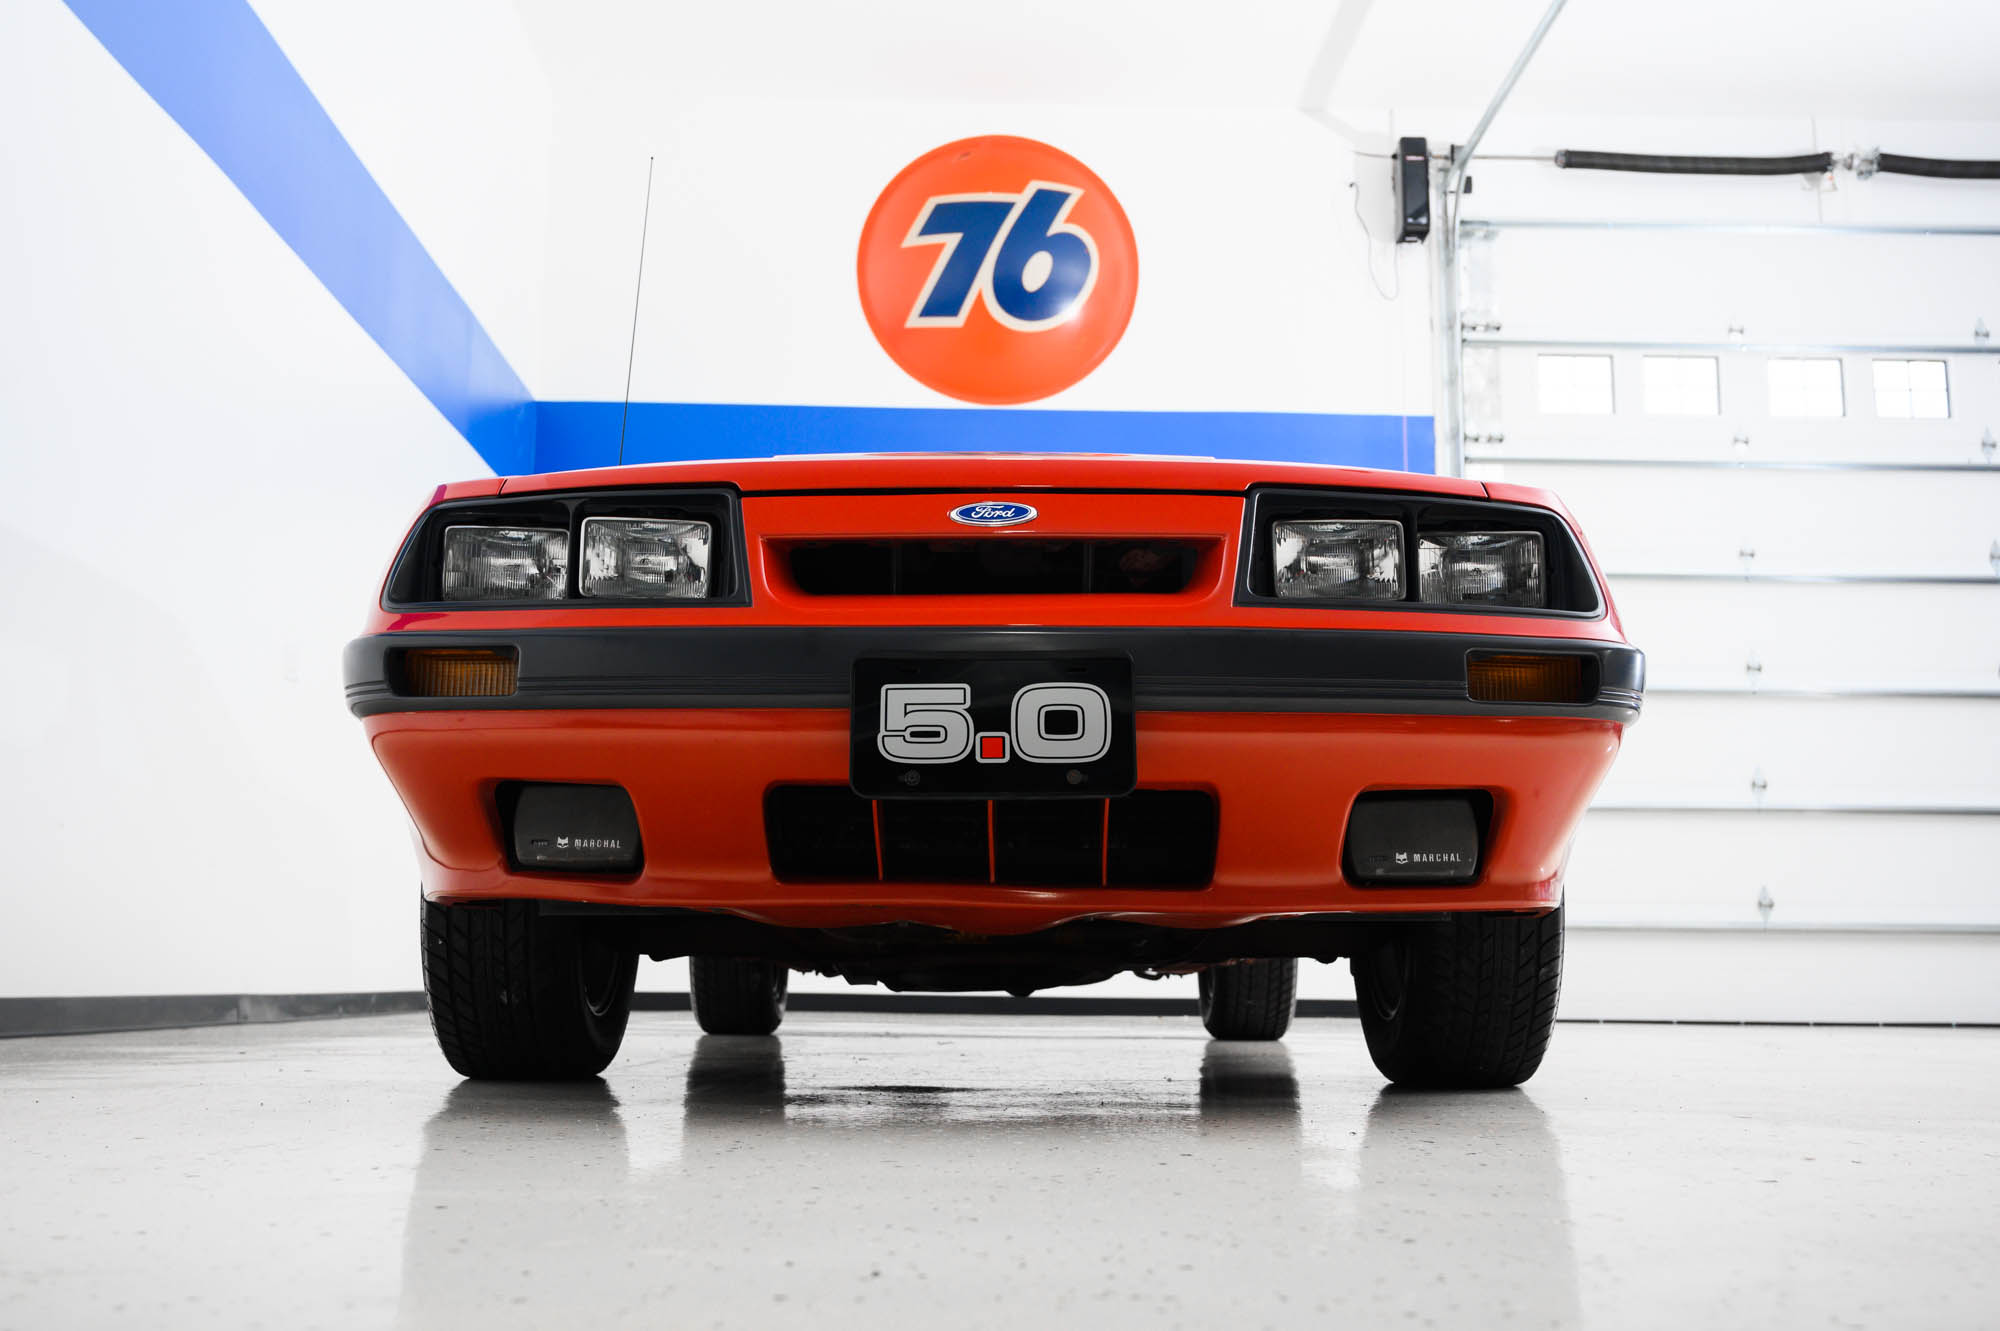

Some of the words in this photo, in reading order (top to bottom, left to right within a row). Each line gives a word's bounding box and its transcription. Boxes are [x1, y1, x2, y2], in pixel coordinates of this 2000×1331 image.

[901, 180, 1100, 333] 76
[971, 505, 1016, 518] Ford
[877, 682, 1112, 764] 5.0
[574, 838, 621, 849] MARCHAL
[1413, 853, 1462, 862] MARCHAL
